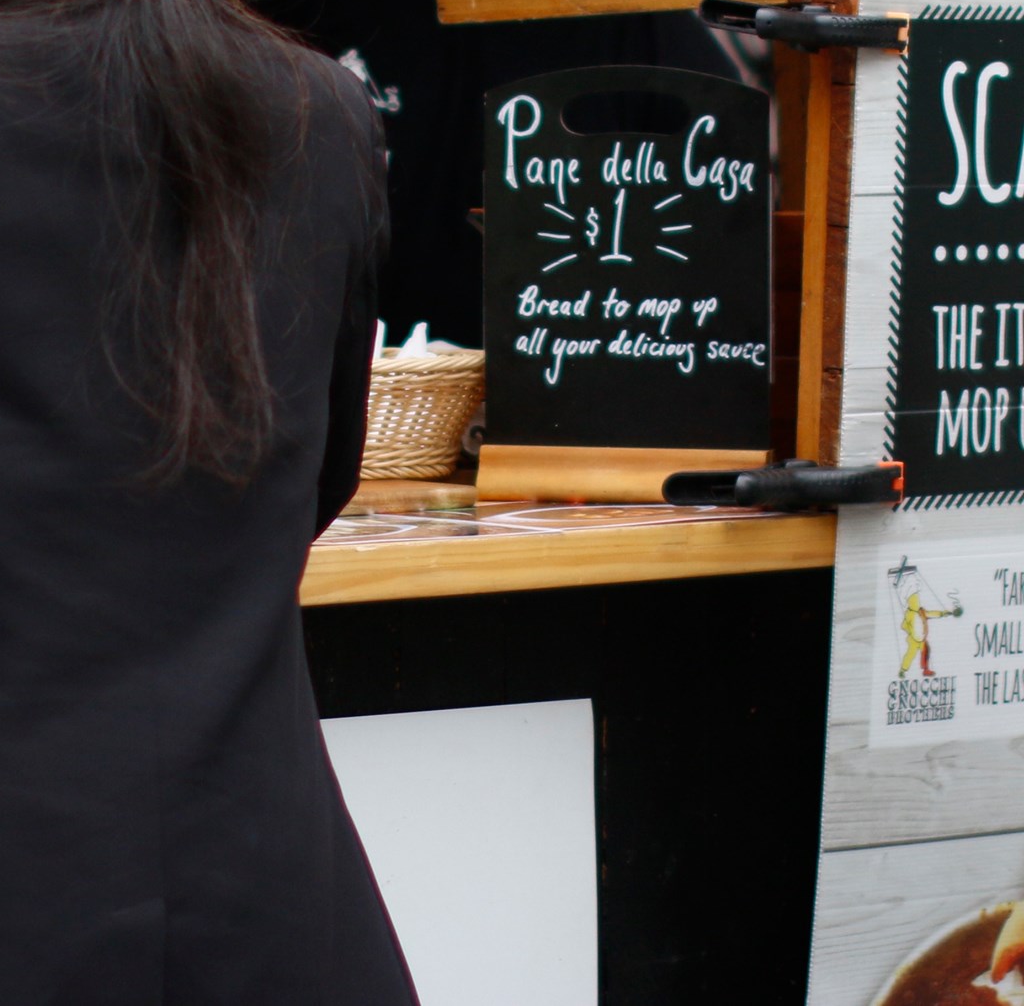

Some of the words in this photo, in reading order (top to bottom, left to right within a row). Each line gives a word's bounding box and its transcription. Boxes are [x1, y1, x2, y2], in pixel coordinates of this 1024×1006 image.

[497, 94, 580, 206] Pane
[603, 141, 668, 186] della
[684, 115, 756, 201] Casa
[938, 60, 1024, 206] SC
[518, 285, 591, 317] Bread
[602, 287, 632, 319] to
[637, 297, 682, 336] mop
[692, 297, 718, 328] up
[932, 304, 985, 370] THE
[516, 327, 548, 355] all
[545, 337, 601, 385] your
[608, 329, 695, 374] delicious
[706, 340, 767, 367] sauce
[936, 387, 1010, 458] MOP
[974, 671, 1000, 706] THE
